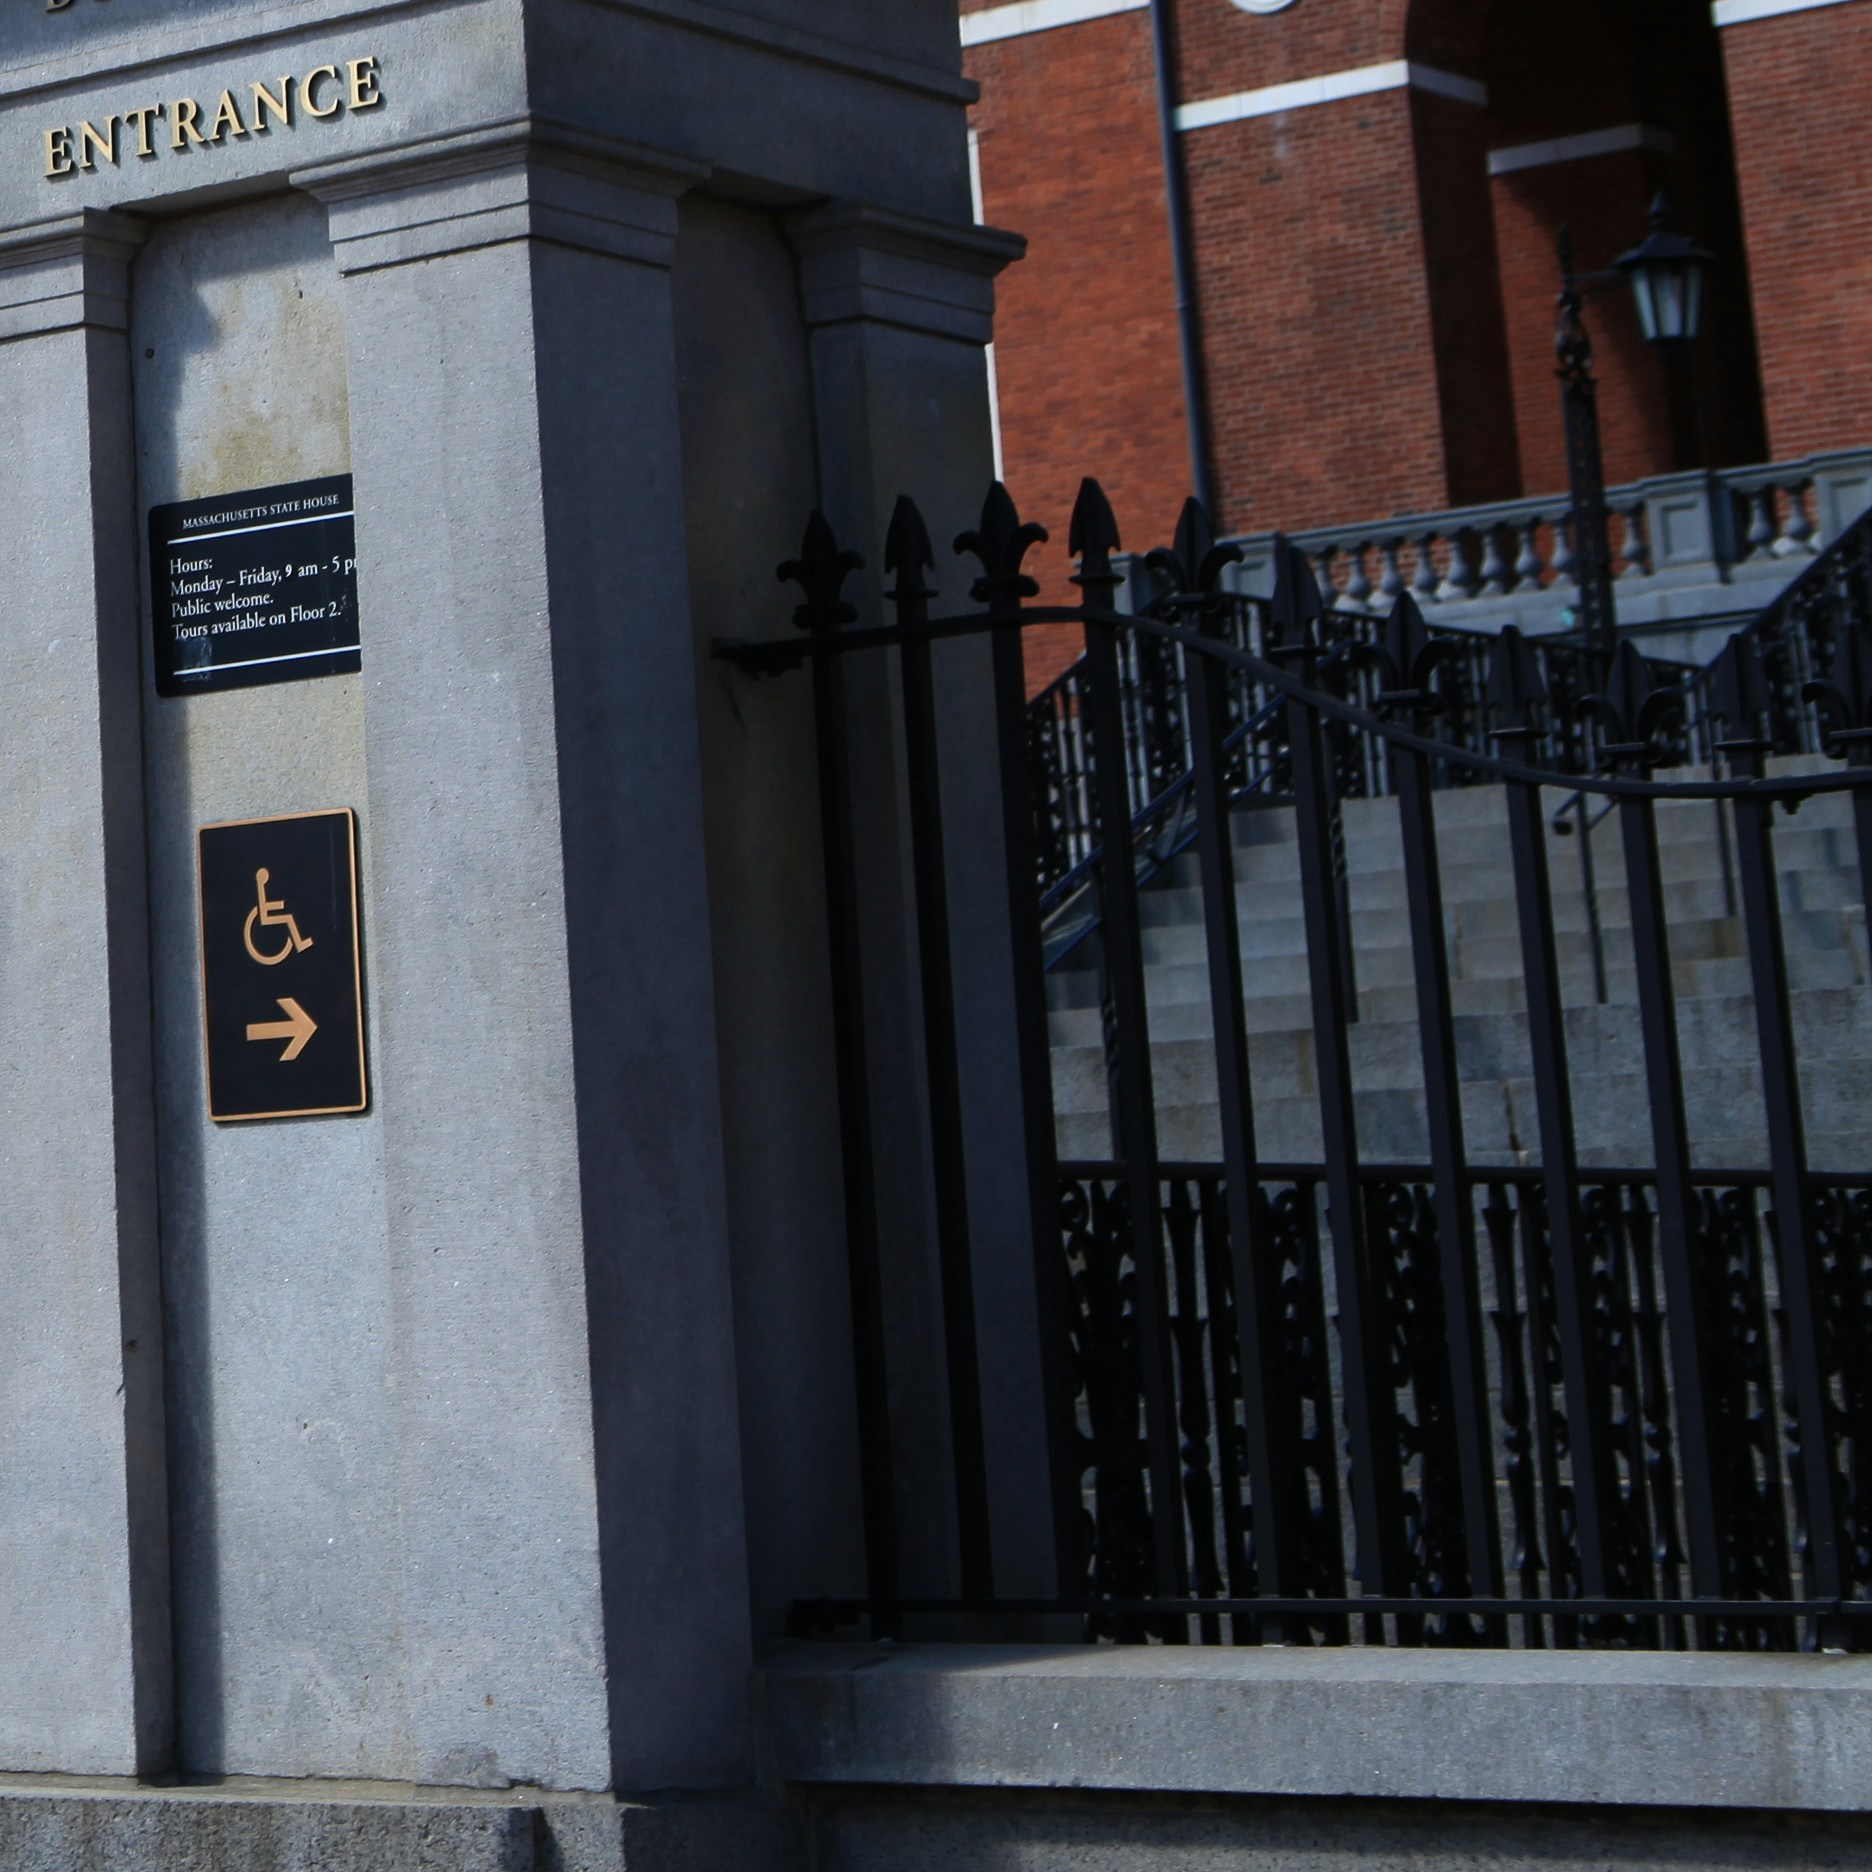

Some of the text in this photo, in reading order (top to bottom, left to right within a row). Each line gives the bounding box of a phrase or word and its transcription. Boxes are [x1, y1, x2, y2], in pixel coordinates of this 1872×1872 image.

[43, 56, 381, 178] ENTRANCE
[182, 494, 339, 530] MASSACHUSETTS STATE HOUSE
[170, 557, 213, 575] Hours:
[170, 574, 224, 597] Monday
[239, 566, 282, 587] Friday,
[285, 564, 292, 577] 9
[297, 563, 318, 578] am
[331, 555, 340, 573] 5
[171, 592, 274, 618] Public welcome.
[172, 600, 342, 640] Tours available on Floor 2.
